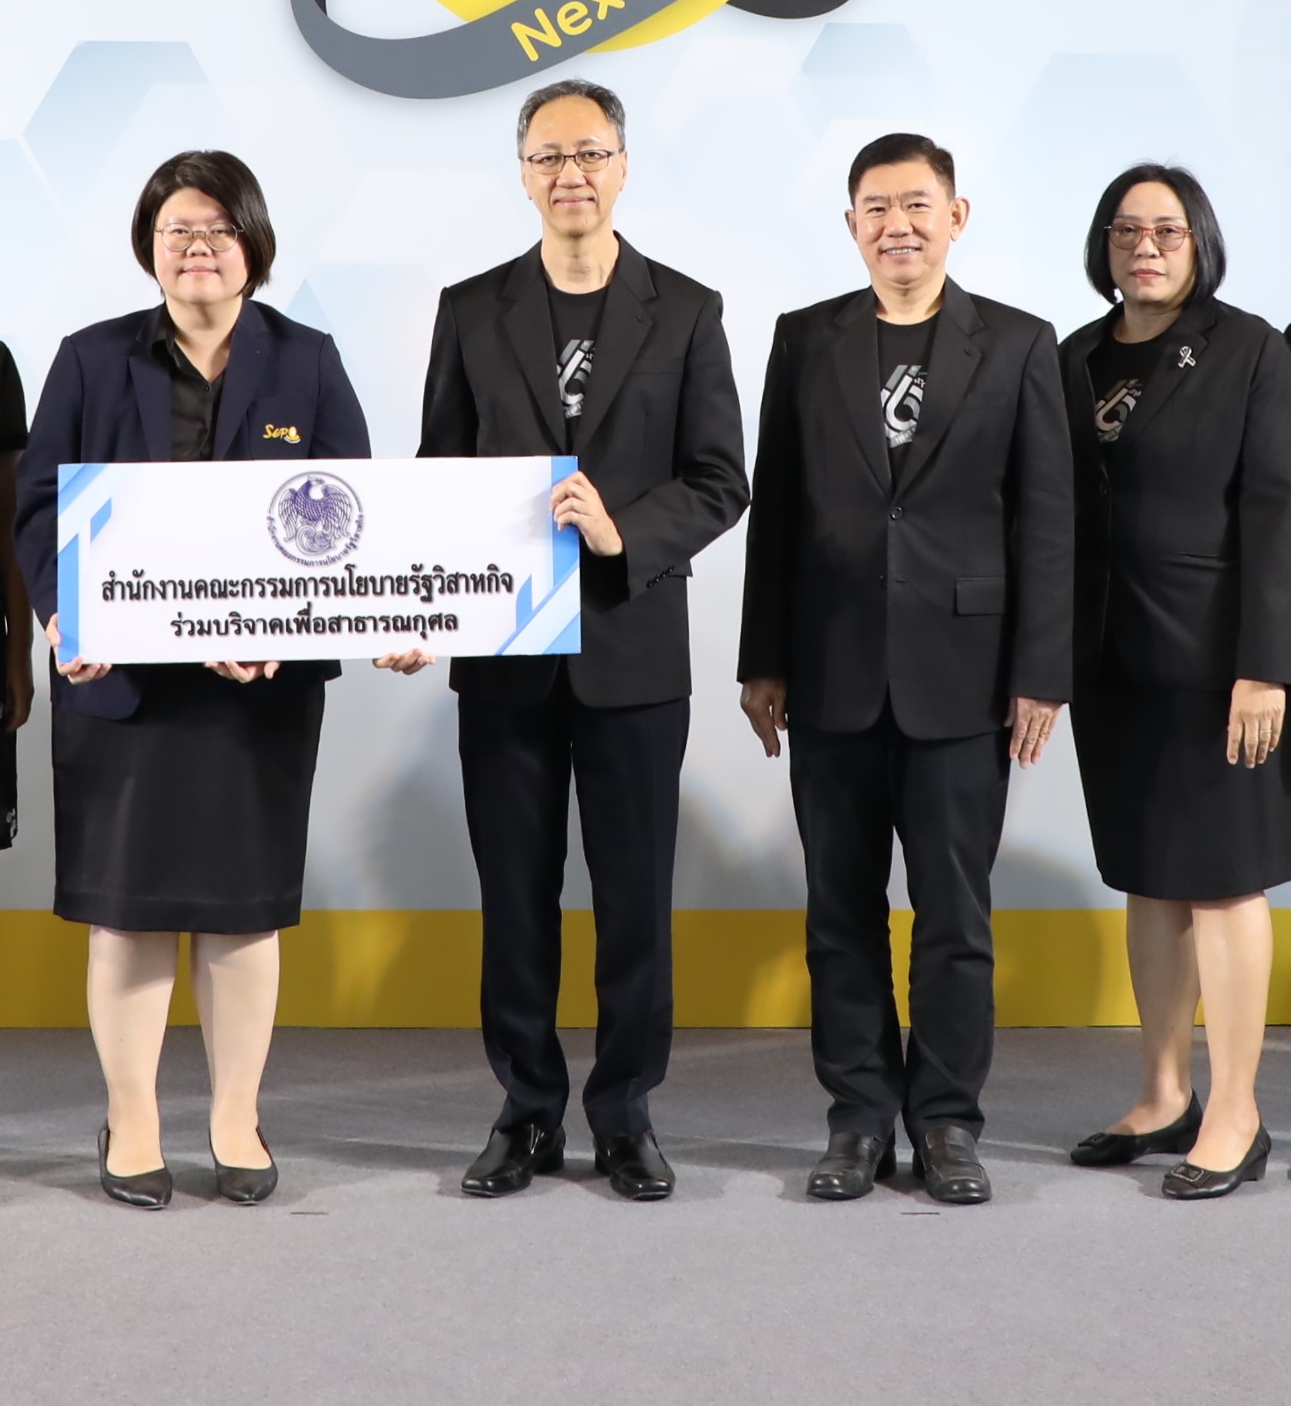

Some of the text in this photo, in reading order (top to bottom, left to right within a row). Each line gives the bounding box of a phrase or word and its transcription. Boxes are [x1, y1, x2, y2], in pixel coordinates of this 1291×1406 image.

[101, 563, 514, 603] สำนักงานคณะกรรมการนโยบายรัฐวิสาหกิจ
[170, 600, 459, 641] ร่วมบริจาคเพื่อสาธารณกุศล
